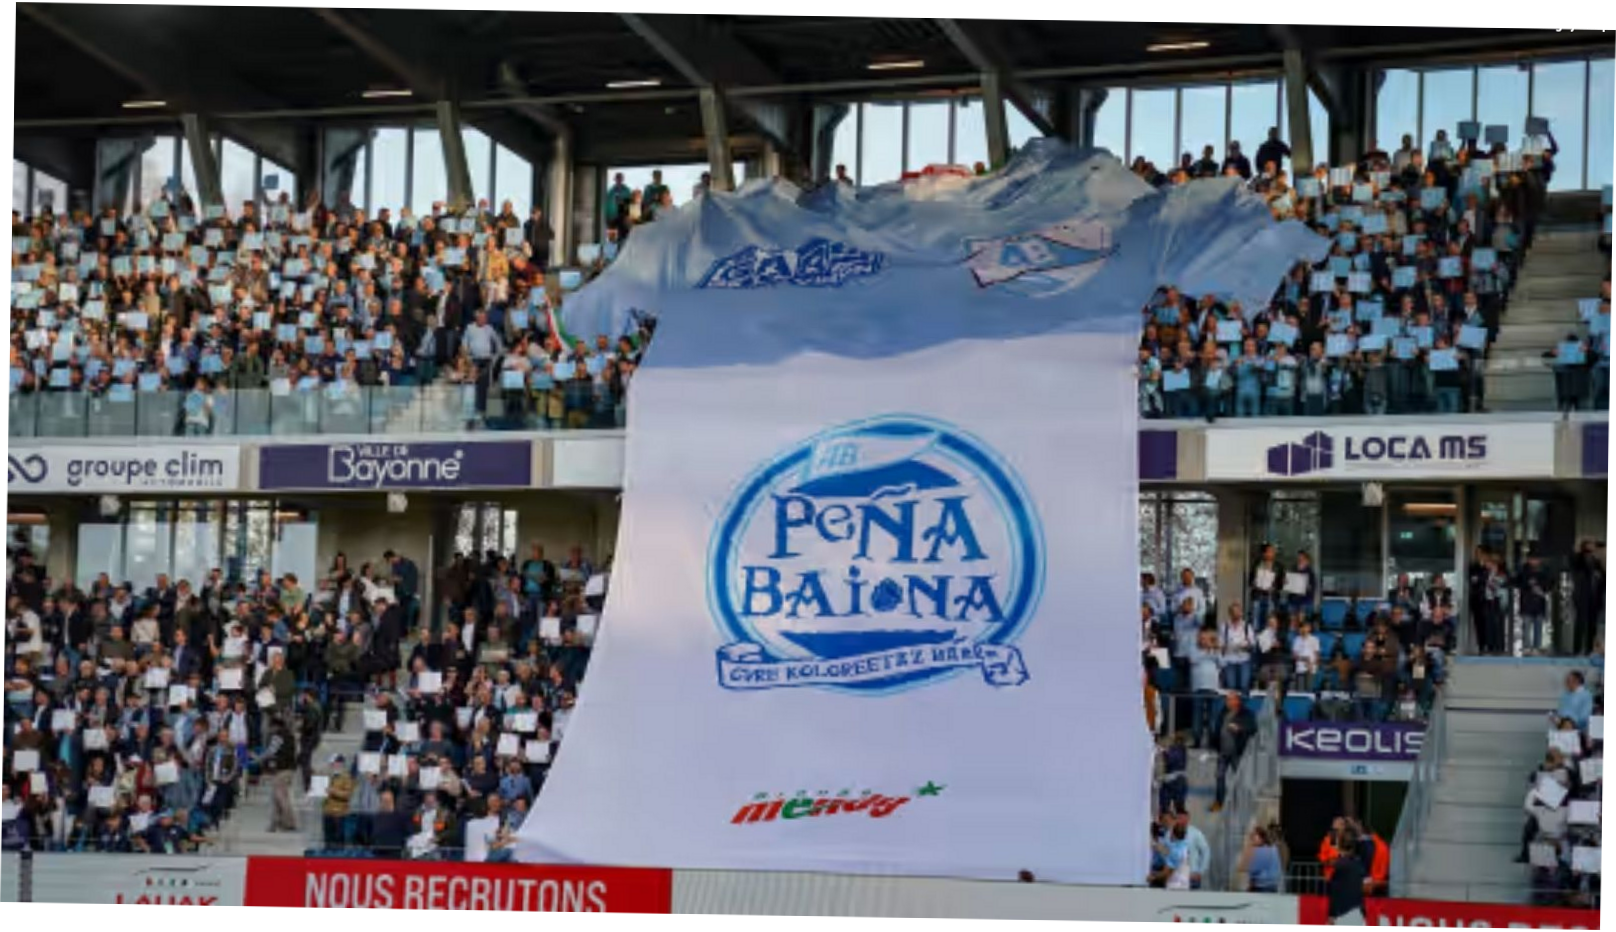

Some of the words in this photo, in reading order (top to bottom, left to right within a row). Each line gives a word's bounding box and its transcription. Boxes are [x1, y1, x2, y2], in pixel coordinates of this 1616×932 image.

[328, 445, 461, 488] Bayonne
[1345, 436, 1432, 460] LOCA
[1439, 435, 1487, 459] MS
[67, 457, 158, 486] groupe
[165, 450, 223, 476] clim
[305, 872, 395, 910] NOUS
[405, 876, 607, 914] RECRUTONS
